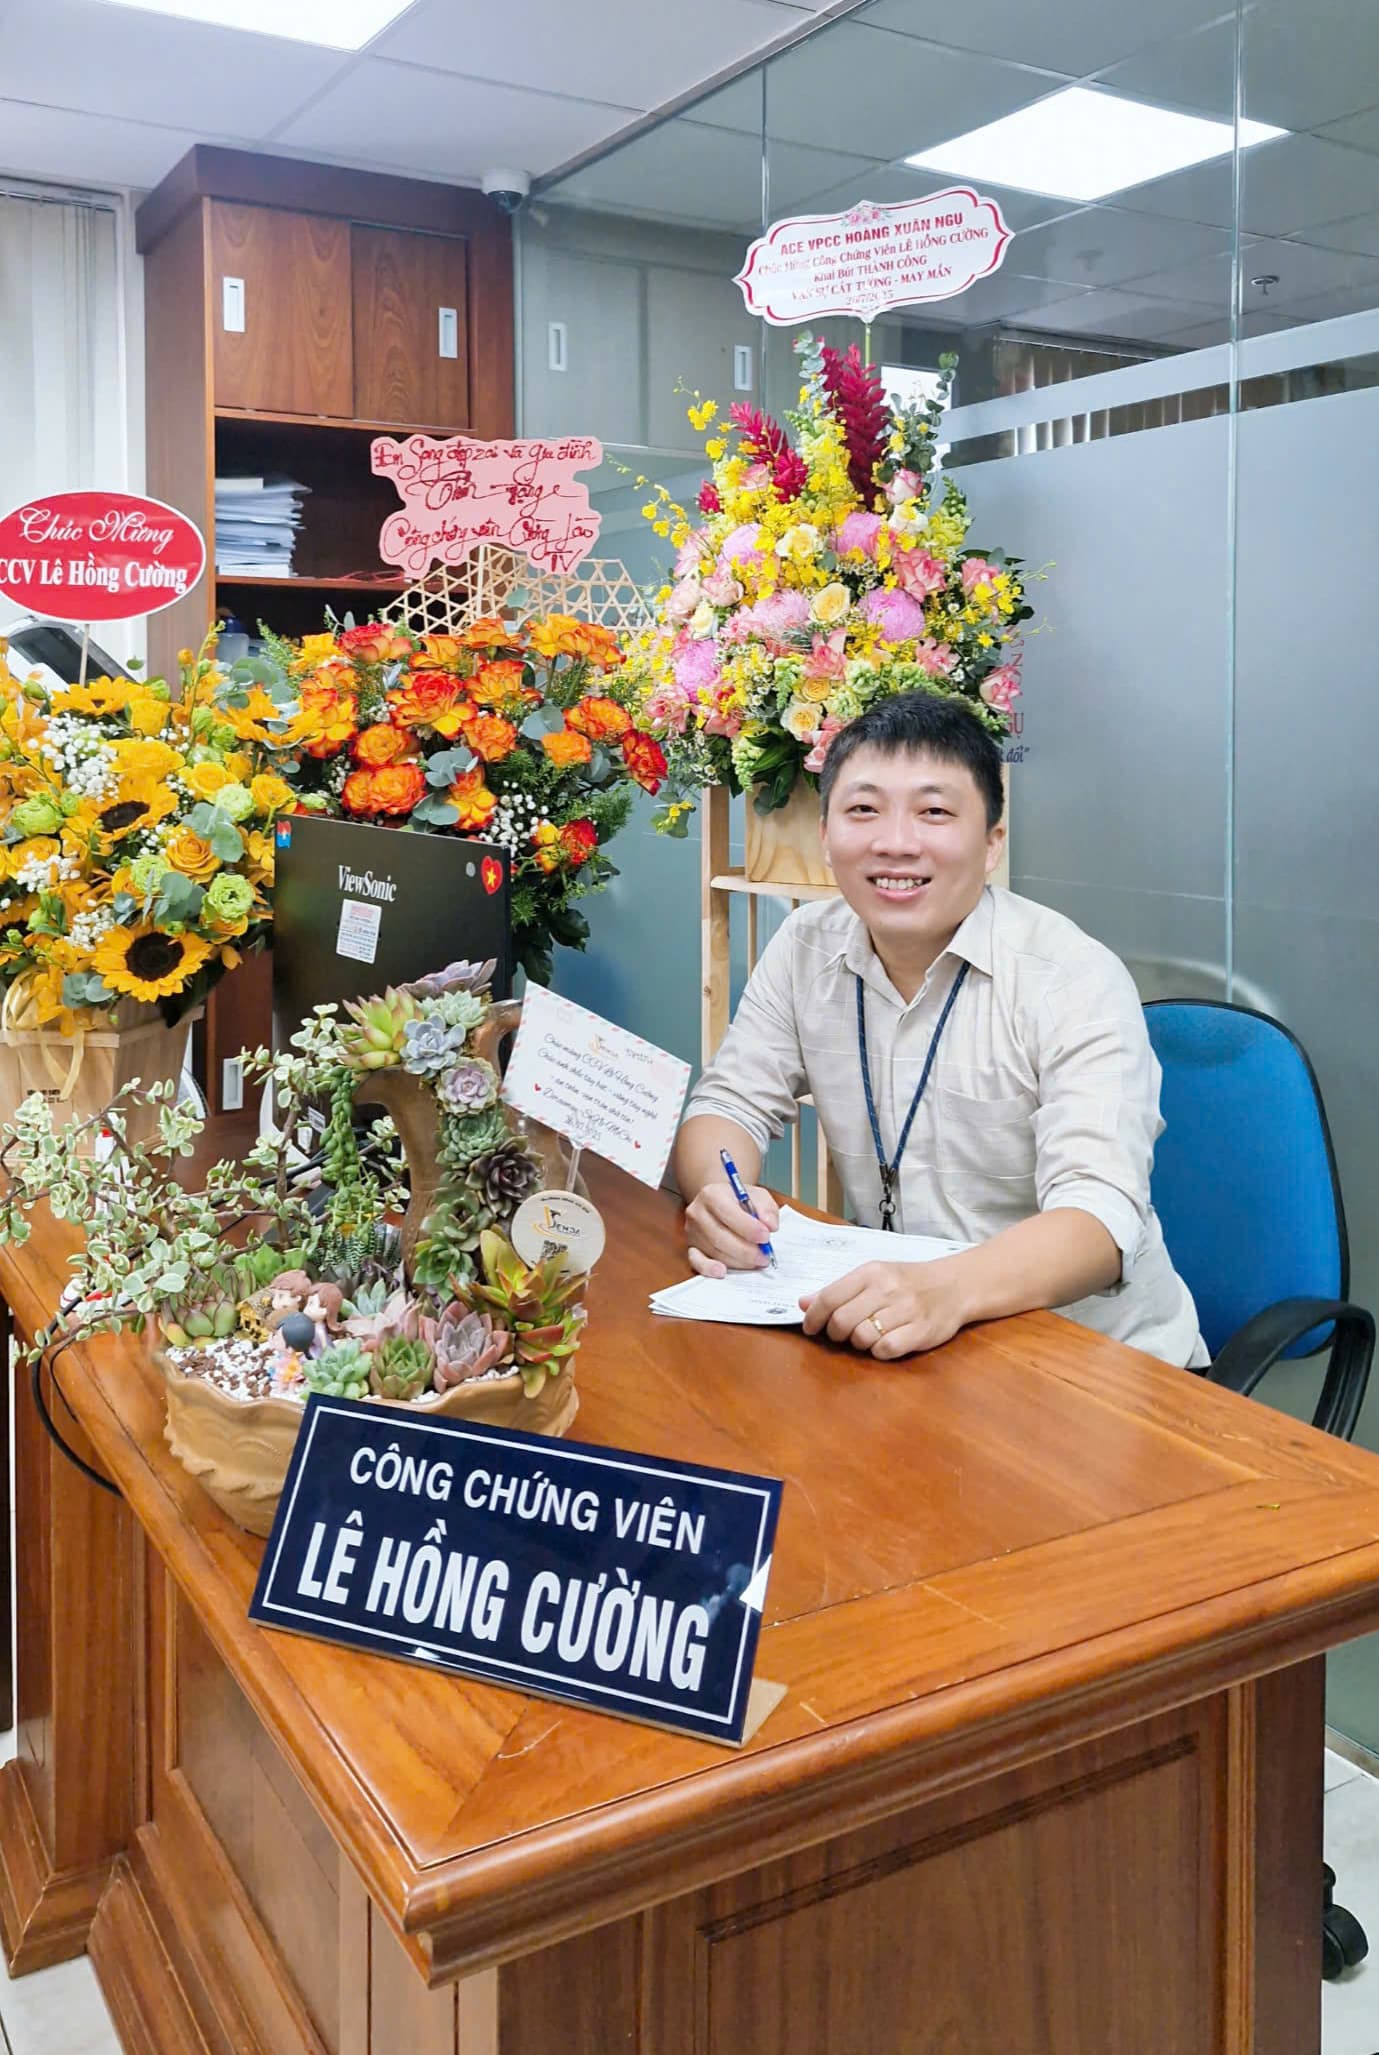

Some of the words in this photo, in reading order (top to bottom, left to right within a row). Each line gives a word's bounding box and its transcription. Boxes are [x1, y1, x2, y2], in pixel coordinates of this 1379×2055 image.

[781, 241, 804, 256] ACE
[808, 235, 841, 250] VPCC
[935, 212, 963, 229] NGỤ
[840, 248, 872, 262] Chứng
[898, 238, 913, 253] LÊ
[950, 227, 989, 244] CƯỜNG
[896, 254, 927, 270] CÔNG
[900, 271, 924, 284] MAY
[18, 507, 83, 544] Chúc
[88, 510, 175, 556] Mừng
[39, 558, 64, 586] Lê
[68, 552, 120, 593] Hồng
[124, 559, 188, 595] Cường
[338, 864, 398, 903] ViewSonic
[349, 1442, 455, 1502] CÔNG
[463, 1470, 600, 1533] CHỨNG
[614, 1496, 706, 1555] VIÊN
[297, 1510, 365, 1606] LÊ
[364, 1518, 510, 1643] HỒNG
[520, 1567, 710, 1692] CƯỜNG
